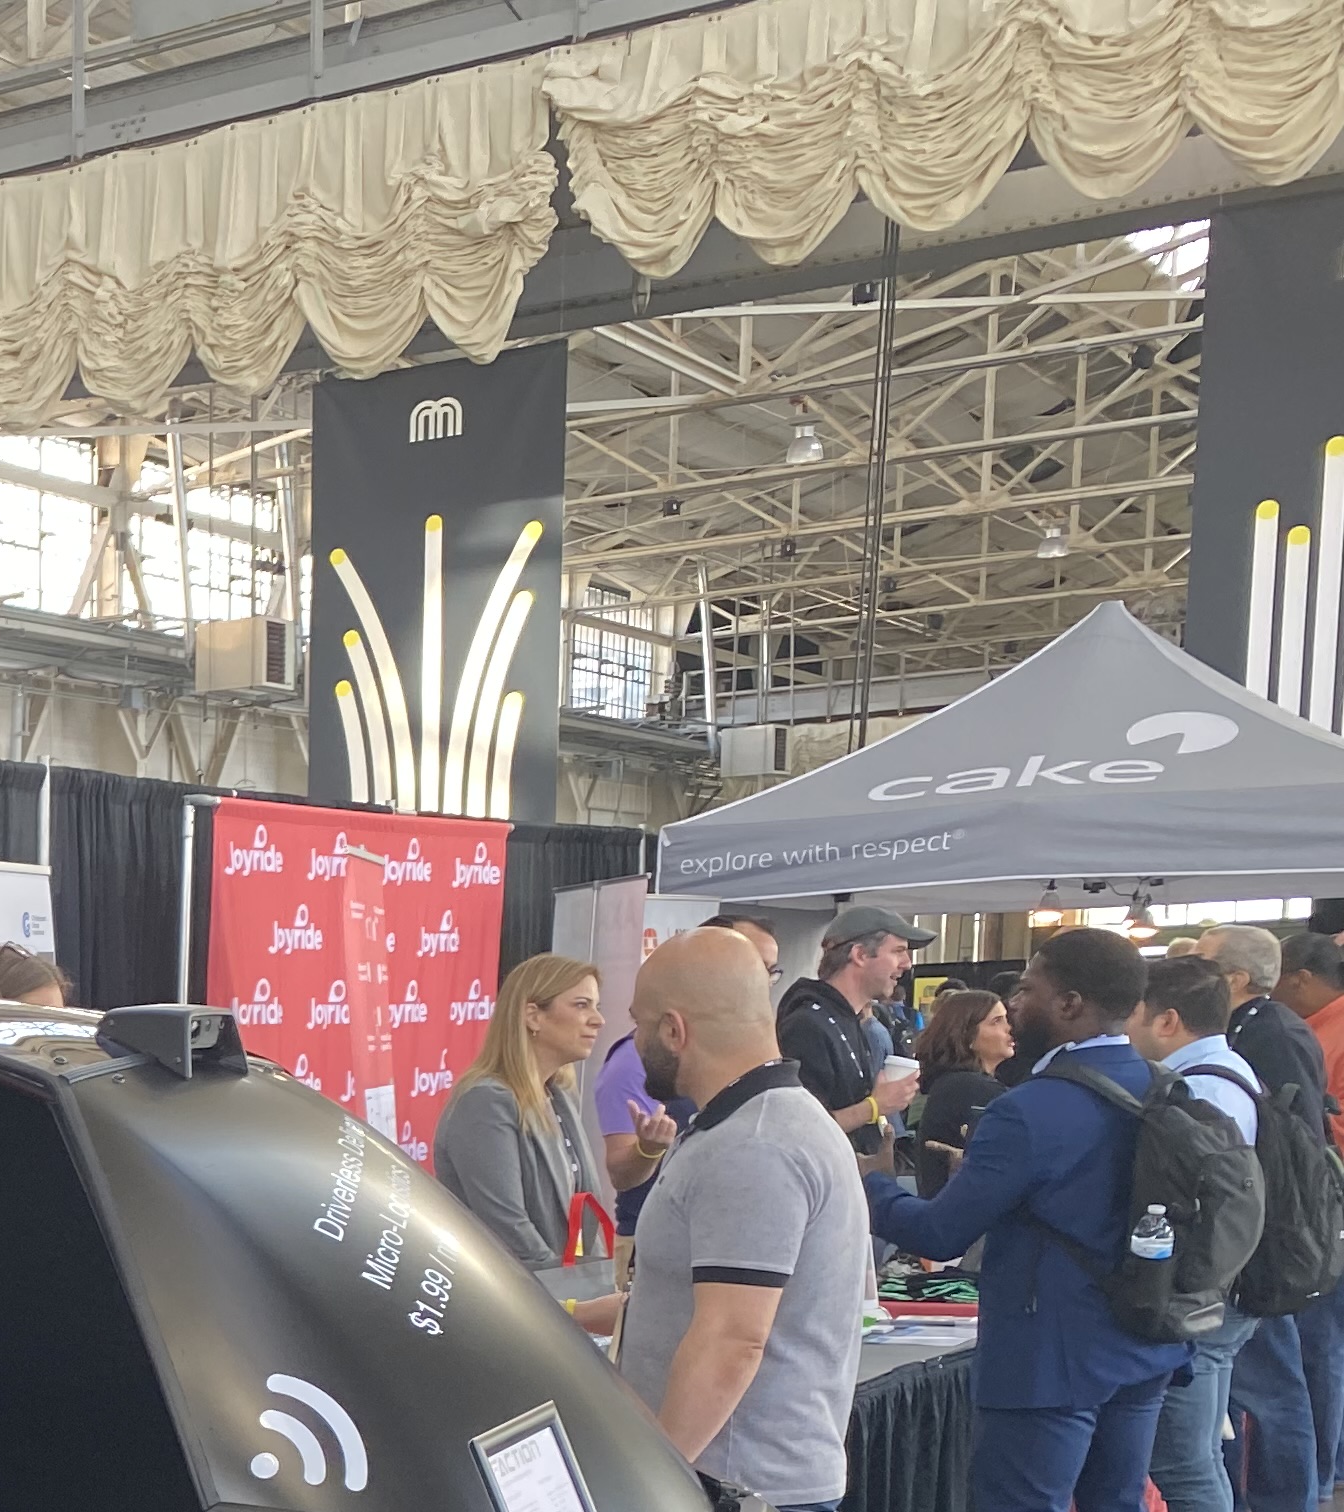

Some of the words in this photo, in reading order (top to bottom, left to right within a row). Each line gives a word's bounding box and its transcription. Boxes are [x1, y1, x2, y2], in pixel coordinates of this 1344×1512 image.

[868, 755, 1166, 801] cake
[224, 824, 283, 876] Joyride
[452, 842, 501, 888] Joyride
[680, 851, 773, 877] explore
[783, 842, 840, 867] with
[268, 903, 323, 954] Joyride
[313, 1152, 364, 1242] Driverless
[408, 1268, 453, 1335] $1.99
